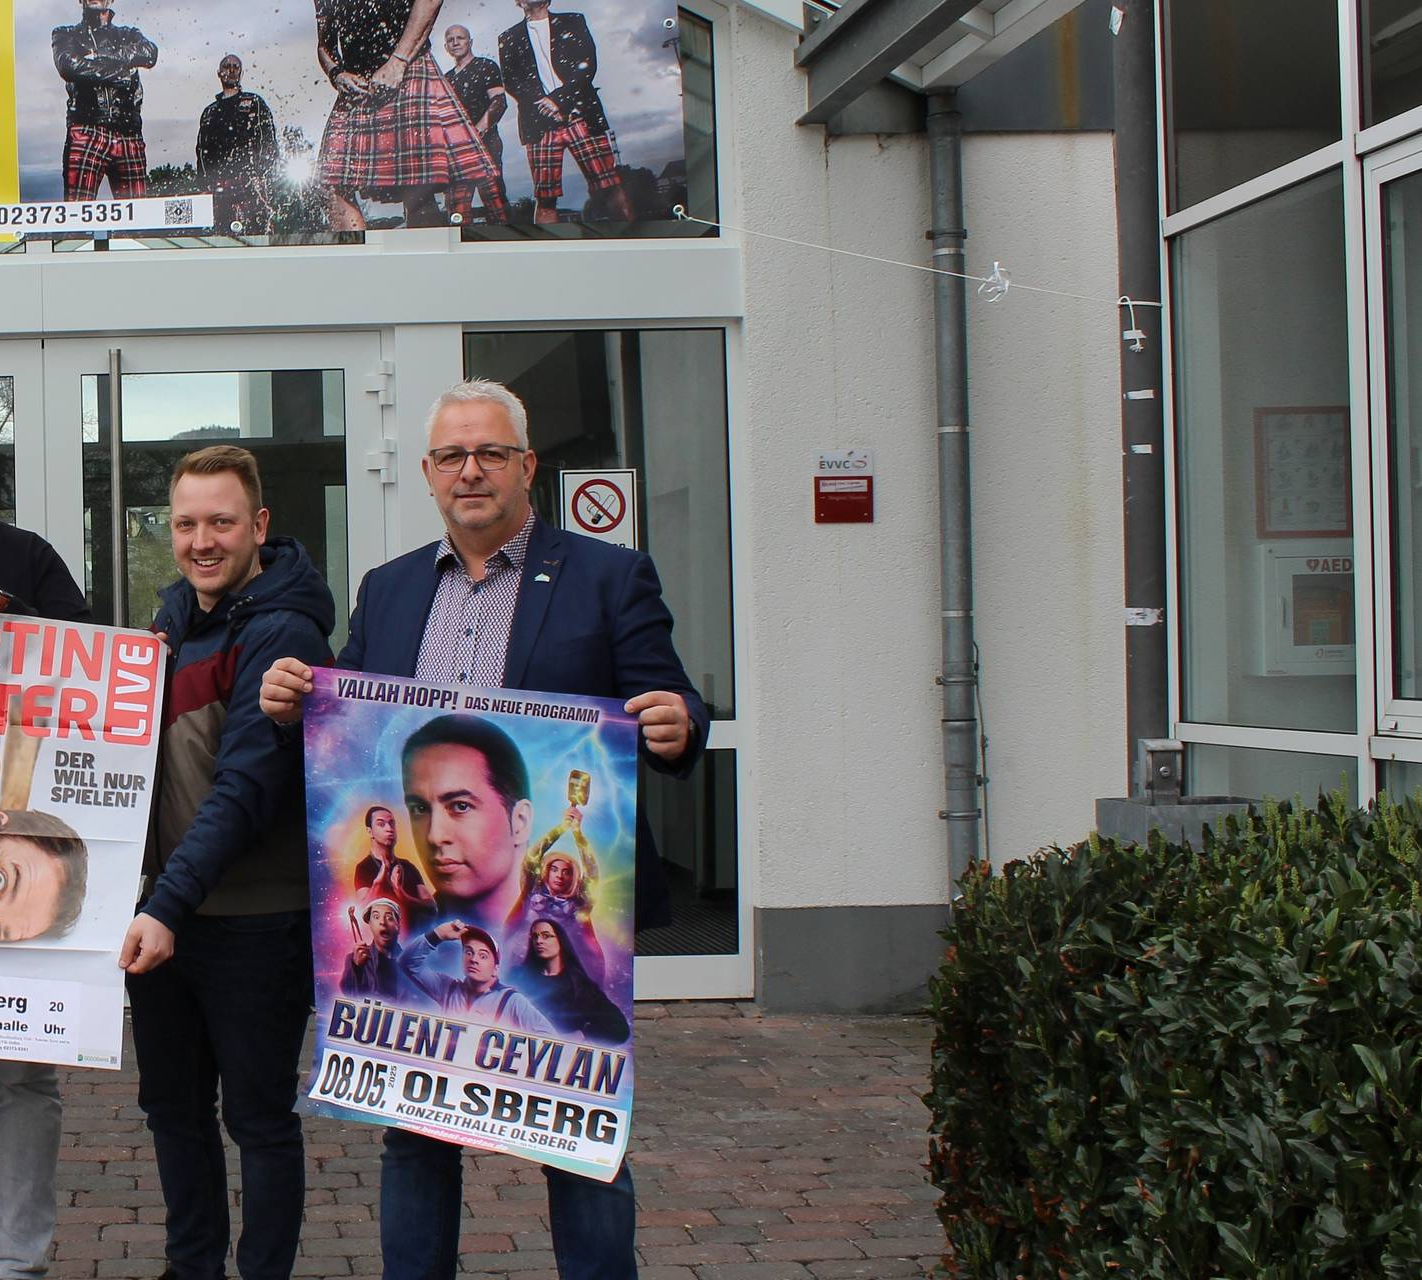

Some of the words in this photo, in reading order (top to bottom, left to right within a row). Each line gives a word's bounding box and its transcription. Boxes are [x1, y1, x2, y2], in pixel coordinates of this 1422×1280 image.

[819, 460, 851, 469] EVVC
[1321, 558, 1352, 573] AED
[111, 643, 154, 738] LIVE
[337, 677, 399, 704] YALLAH
[403, 685, 459, 710] HOPP!
[464, 696, 489, 711] DAS
[491, 698, 522, 715] NEUE
[524, 702, 600, 724] PROGRAMM
[55, 750, 95, 769] DER
[54, 769, 98, 788] WILL
[103, 772, 146, 791] NUR
[50, 786, 137, 808] SPIELEN!
[49, 1001, 65, 1013] 20
[43, 1024, 66, 1036] Uhr
[328, 998, 467, 1063] BÜLENT
[475, 1028, 626, 1096] CEYLAN
[319, 1054, 389, 1109] 08.05.
[388, 1065, 398, 1088] 2025
[402, 1070, 618, 1145] OLSBERG
[396, 1103, 508, 1137] KONZERTHALLE
[510, 1128, 578, 1152] OLSBERG
